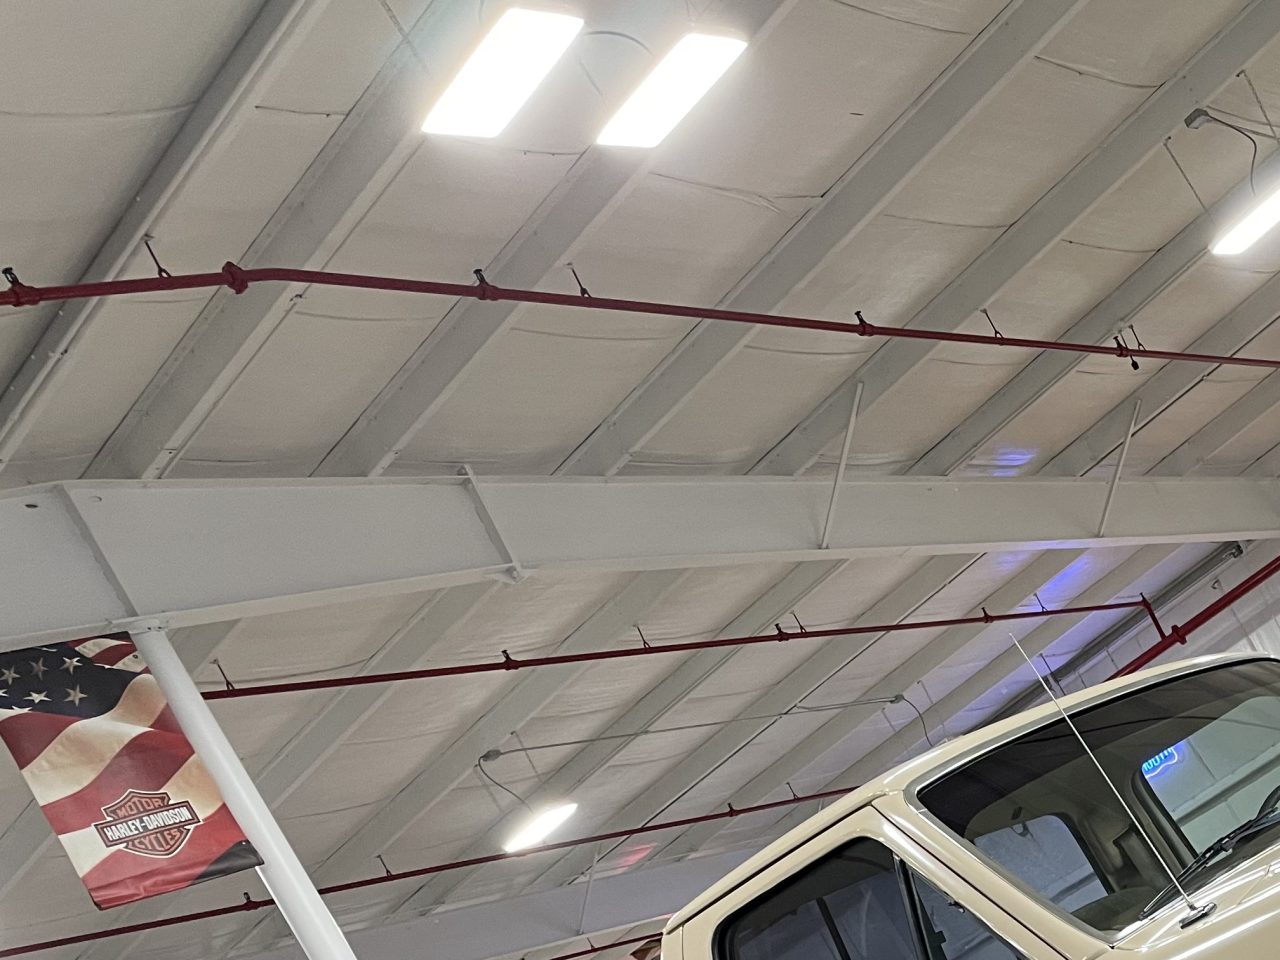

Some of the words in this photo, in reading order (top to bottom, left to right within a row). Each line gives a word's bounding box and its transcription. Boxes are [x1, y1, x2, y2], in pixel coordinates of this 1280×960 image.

[116, 797, 164, 818] MOTOR
[103, 806, 193, 841] HARLEY-DAVIDSON
[133, 827, 181, 851] CYCLES
